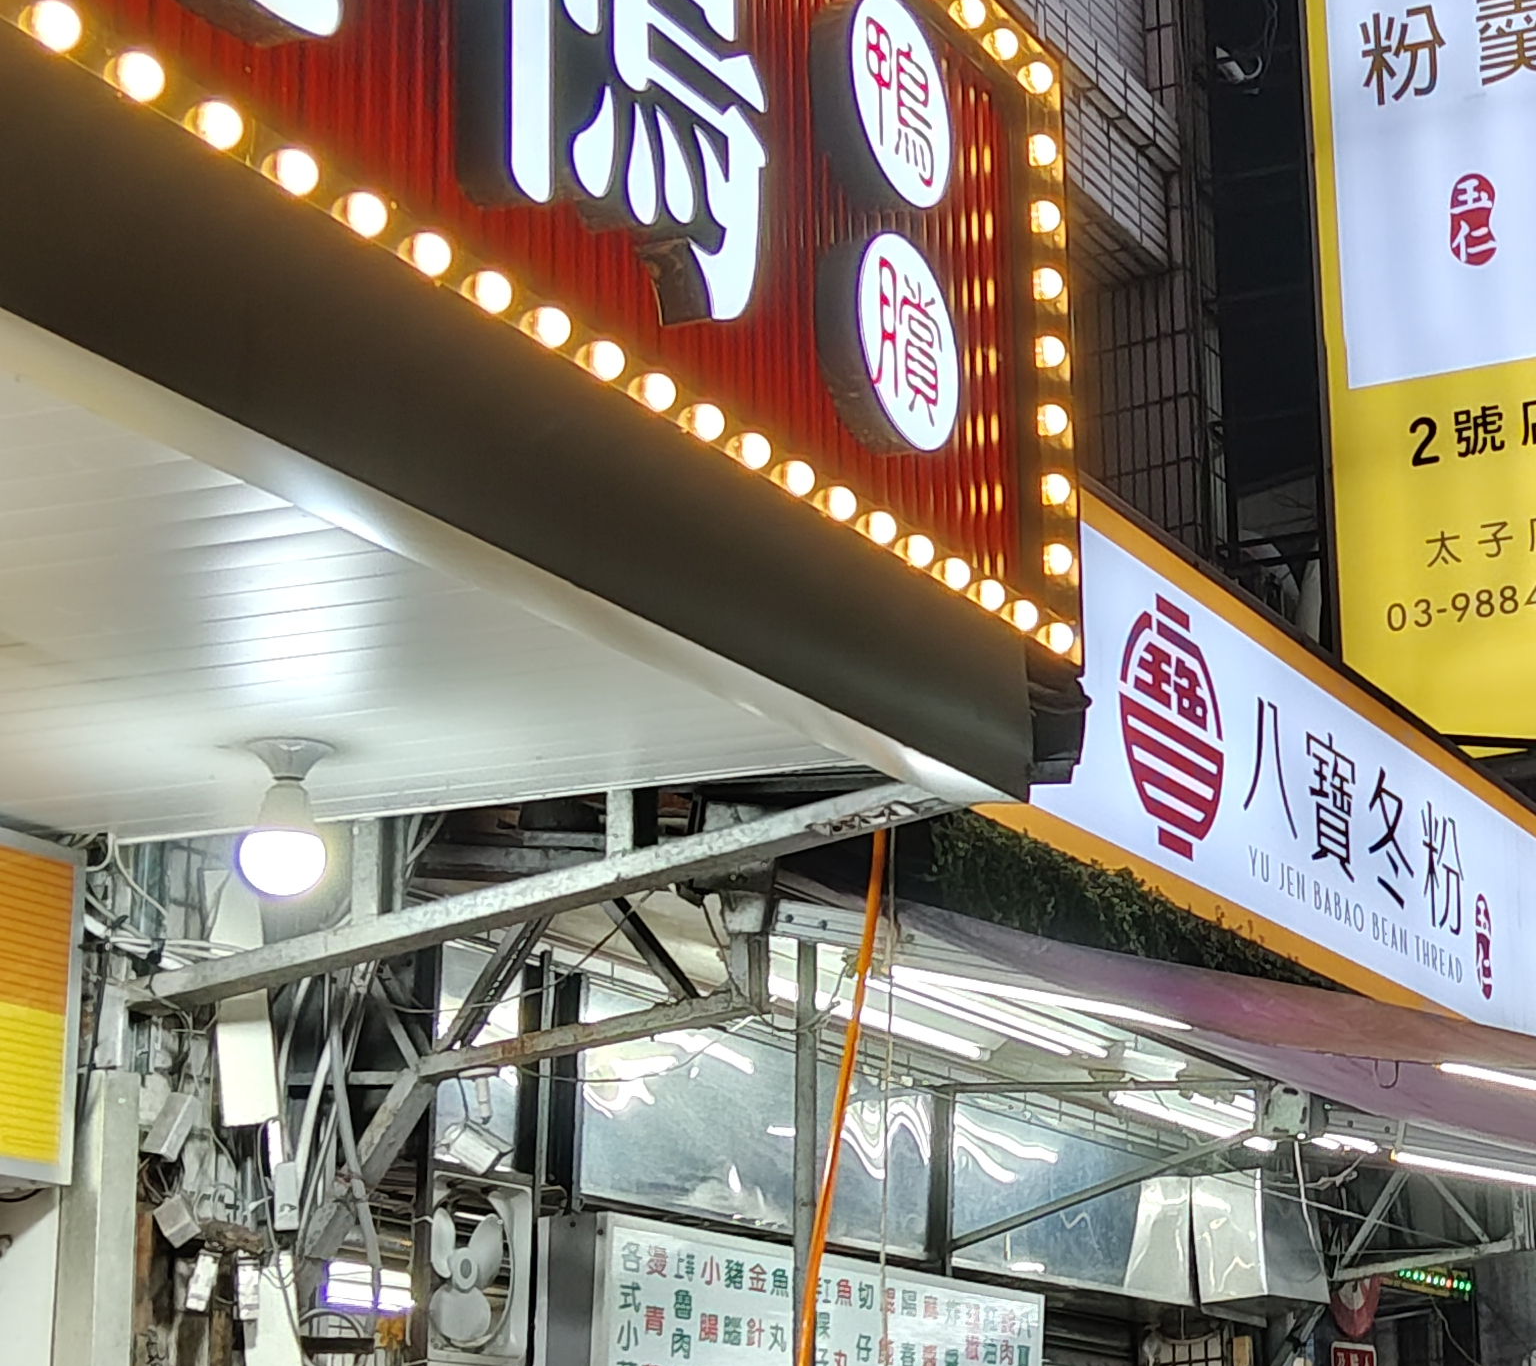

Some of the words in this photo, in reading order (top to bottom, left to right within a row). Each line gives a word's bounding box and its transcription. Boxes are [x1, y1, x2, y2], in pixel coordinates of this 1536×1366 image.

[1450, 175, 1498, 265] 玉仁
[1243, 695, 1465, 937] 八寶冬粉
[1248, 844, 1270, 883] YU
[1279, 862, 1306, 903] JEN
[1313, 880, 1365, 933] BABAO
[1371, 911, 1409, 956] BEAN
[1414, 934, 1464, 984] THREAD
